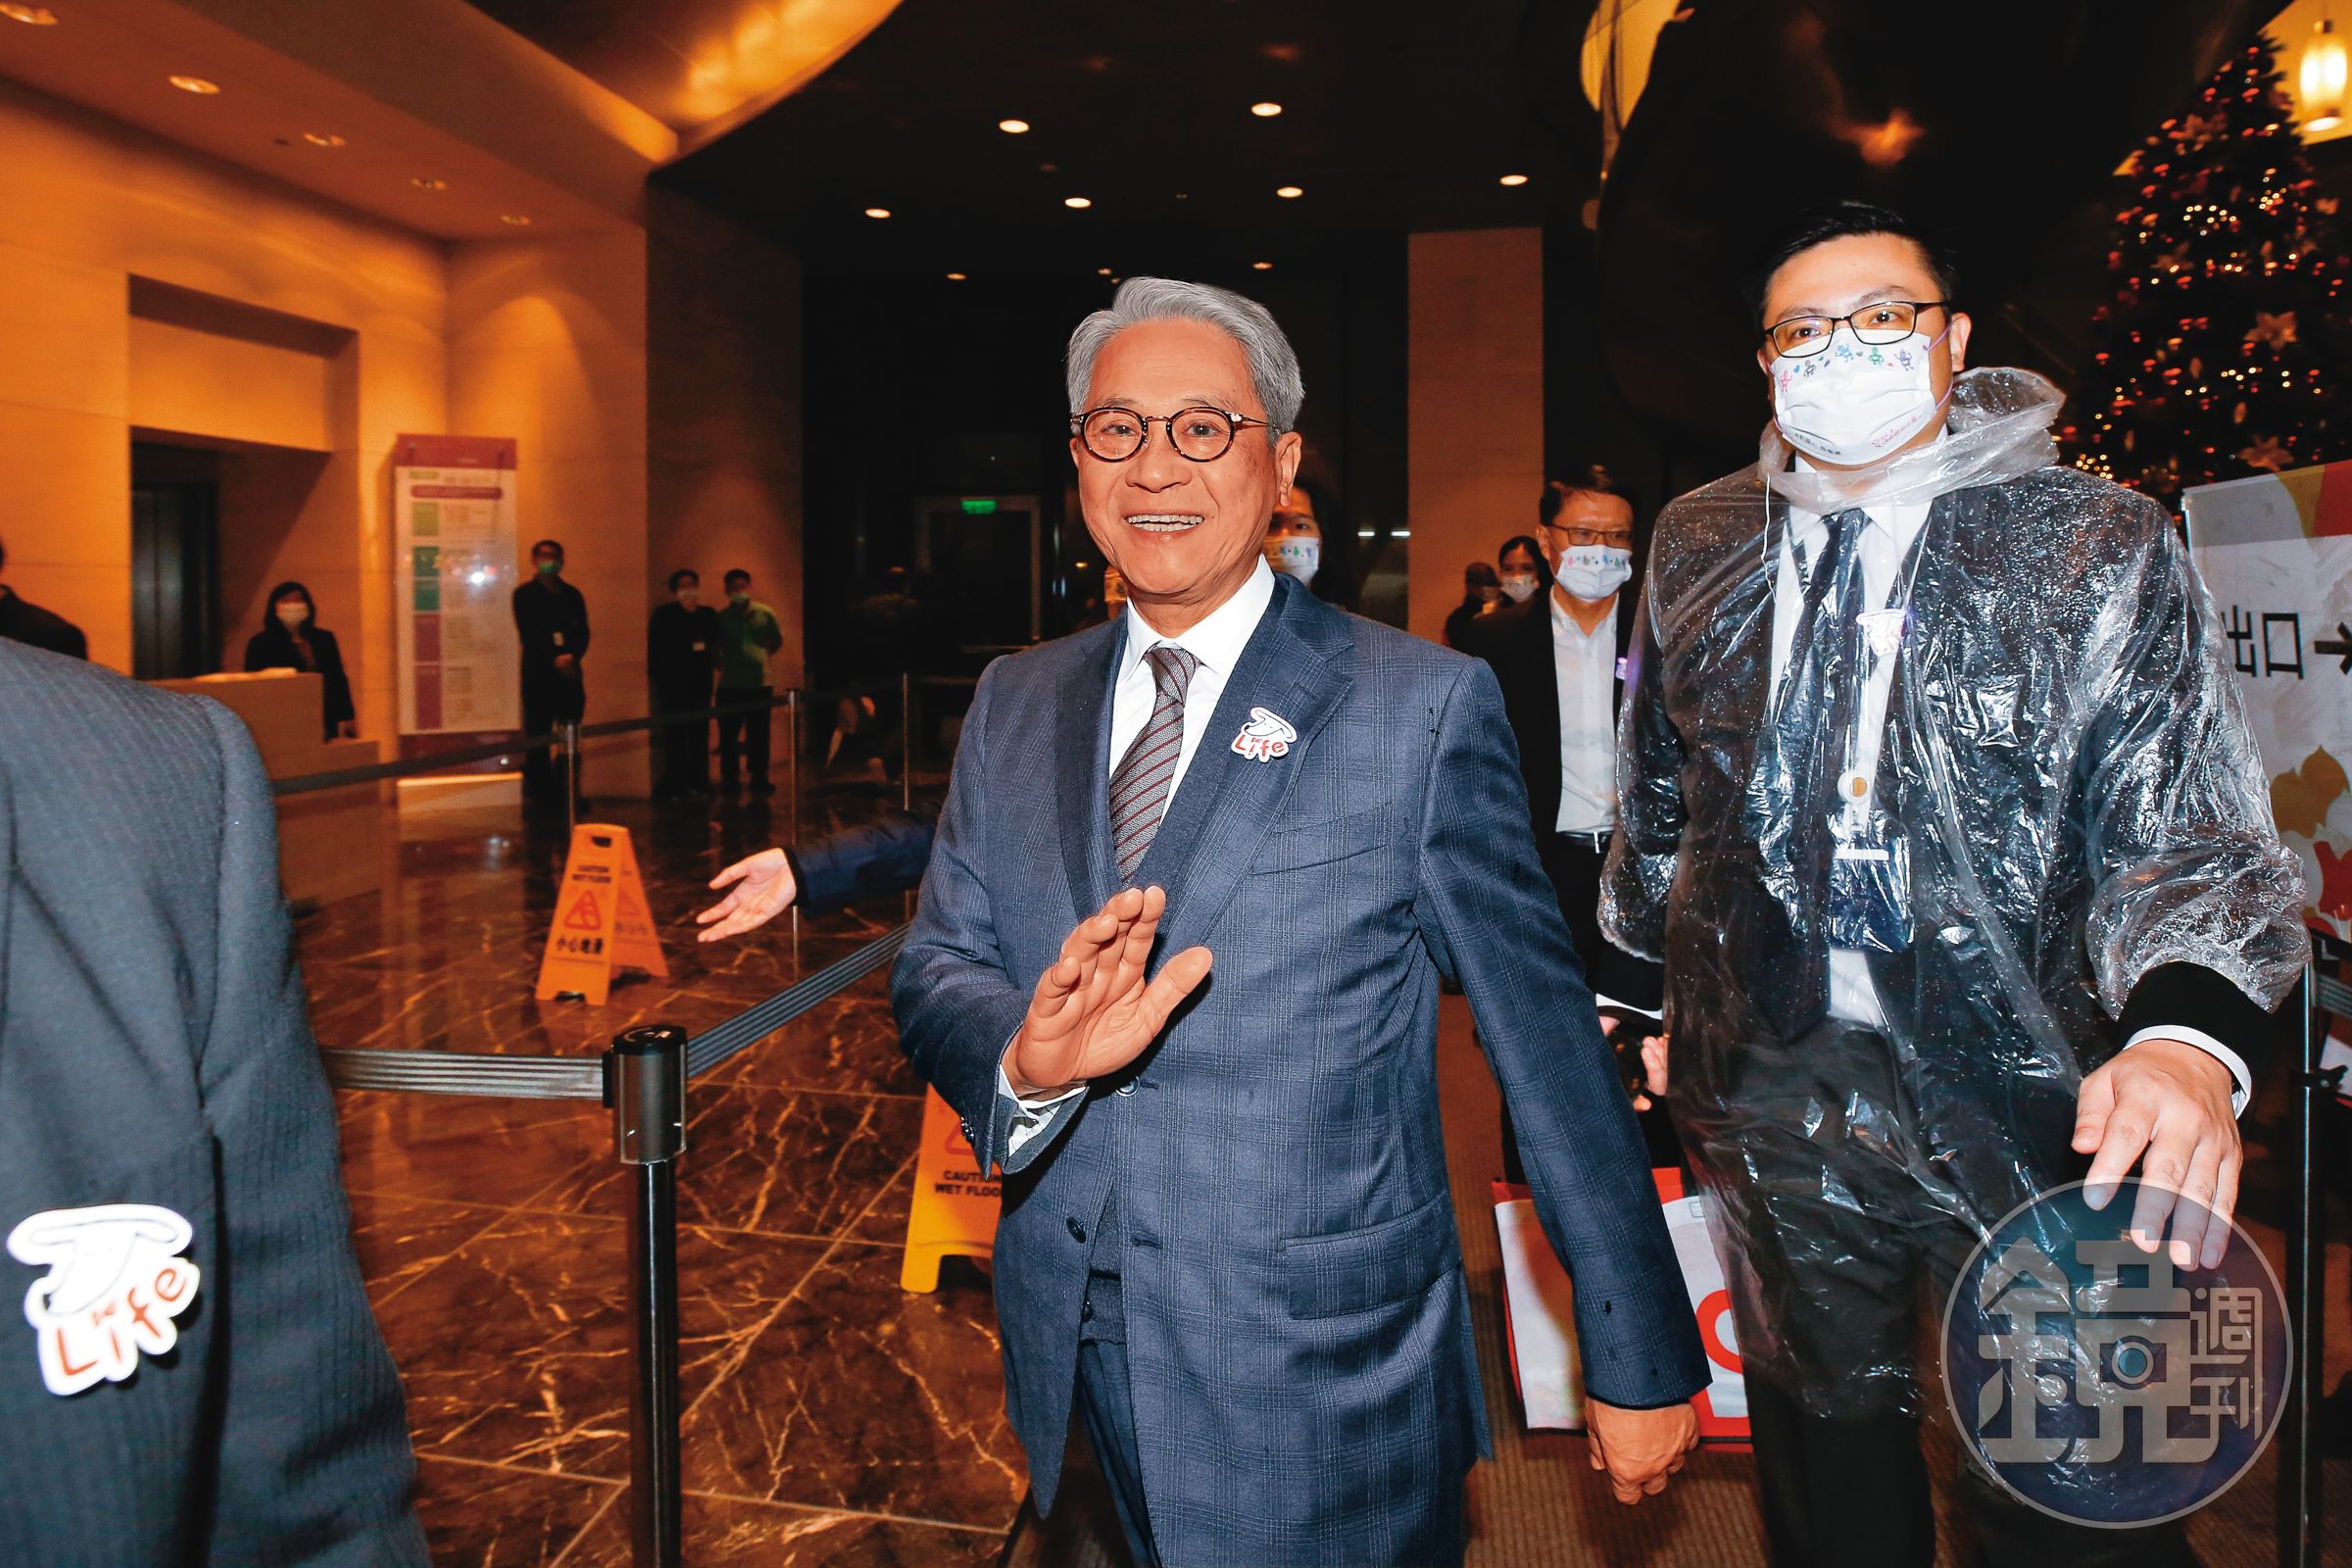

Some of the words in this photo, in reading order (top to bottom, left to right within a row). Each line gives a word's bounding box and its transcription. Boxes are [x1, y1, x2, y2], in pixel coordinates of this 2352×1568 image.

[2220, 605, 2304, 679] 出口
[1235, 734, 1286, 760] Life
[935, 1184, 962, 1195] WET
[966, 1186, 1001, 1197] FLOO
[56, 1267, 188, 1376] Life
